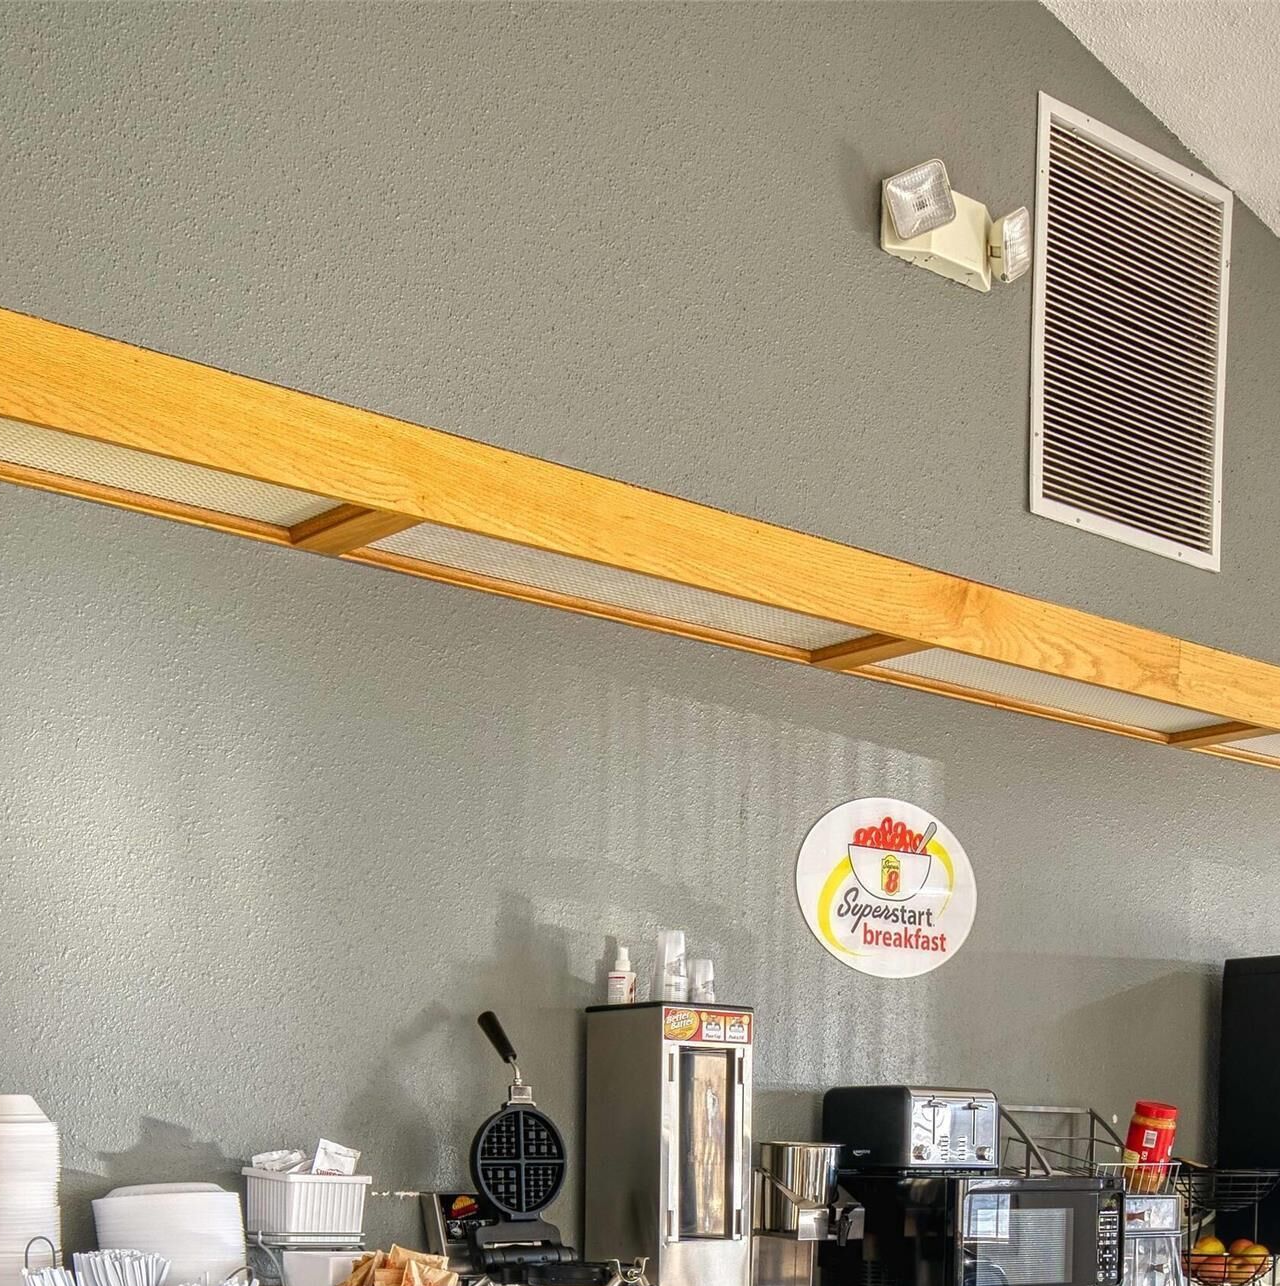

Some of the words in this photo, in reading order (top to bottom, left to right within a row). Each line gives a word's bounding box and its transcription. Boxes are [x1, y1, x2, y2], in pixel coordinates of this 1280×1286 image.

[885, 871, 898, 893] 8
[837, 887, 934, 934] Superstart
[863, 922, 947, 953] breakfast
